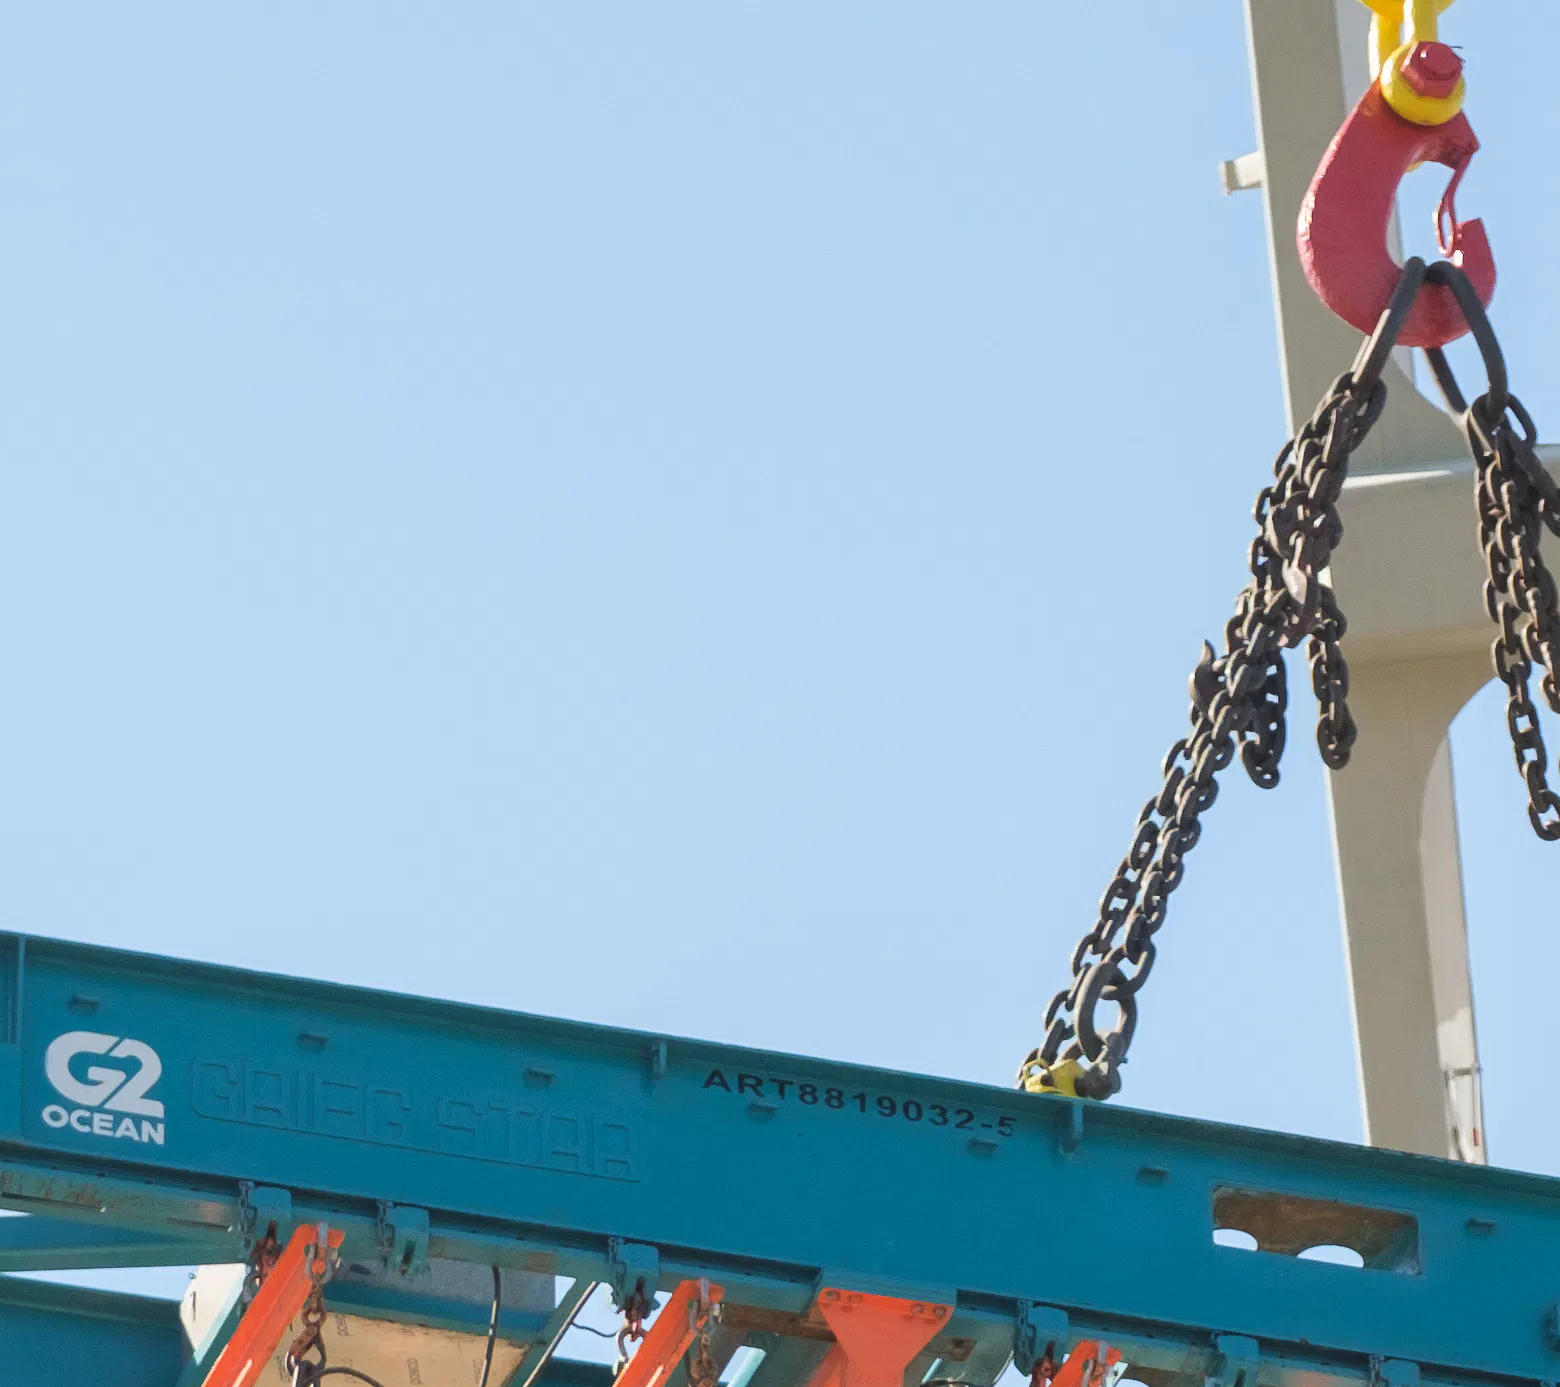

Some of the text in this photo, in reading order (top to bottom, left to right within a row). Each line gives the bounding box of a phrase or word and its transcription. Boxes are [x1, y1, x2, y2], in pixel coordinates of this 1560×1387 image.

[44, 1030, 165, 1118] G2
[702, 1069, 1017, 1138] ART8819032-5
[42, 1105, 165, 1145] OCEAN
